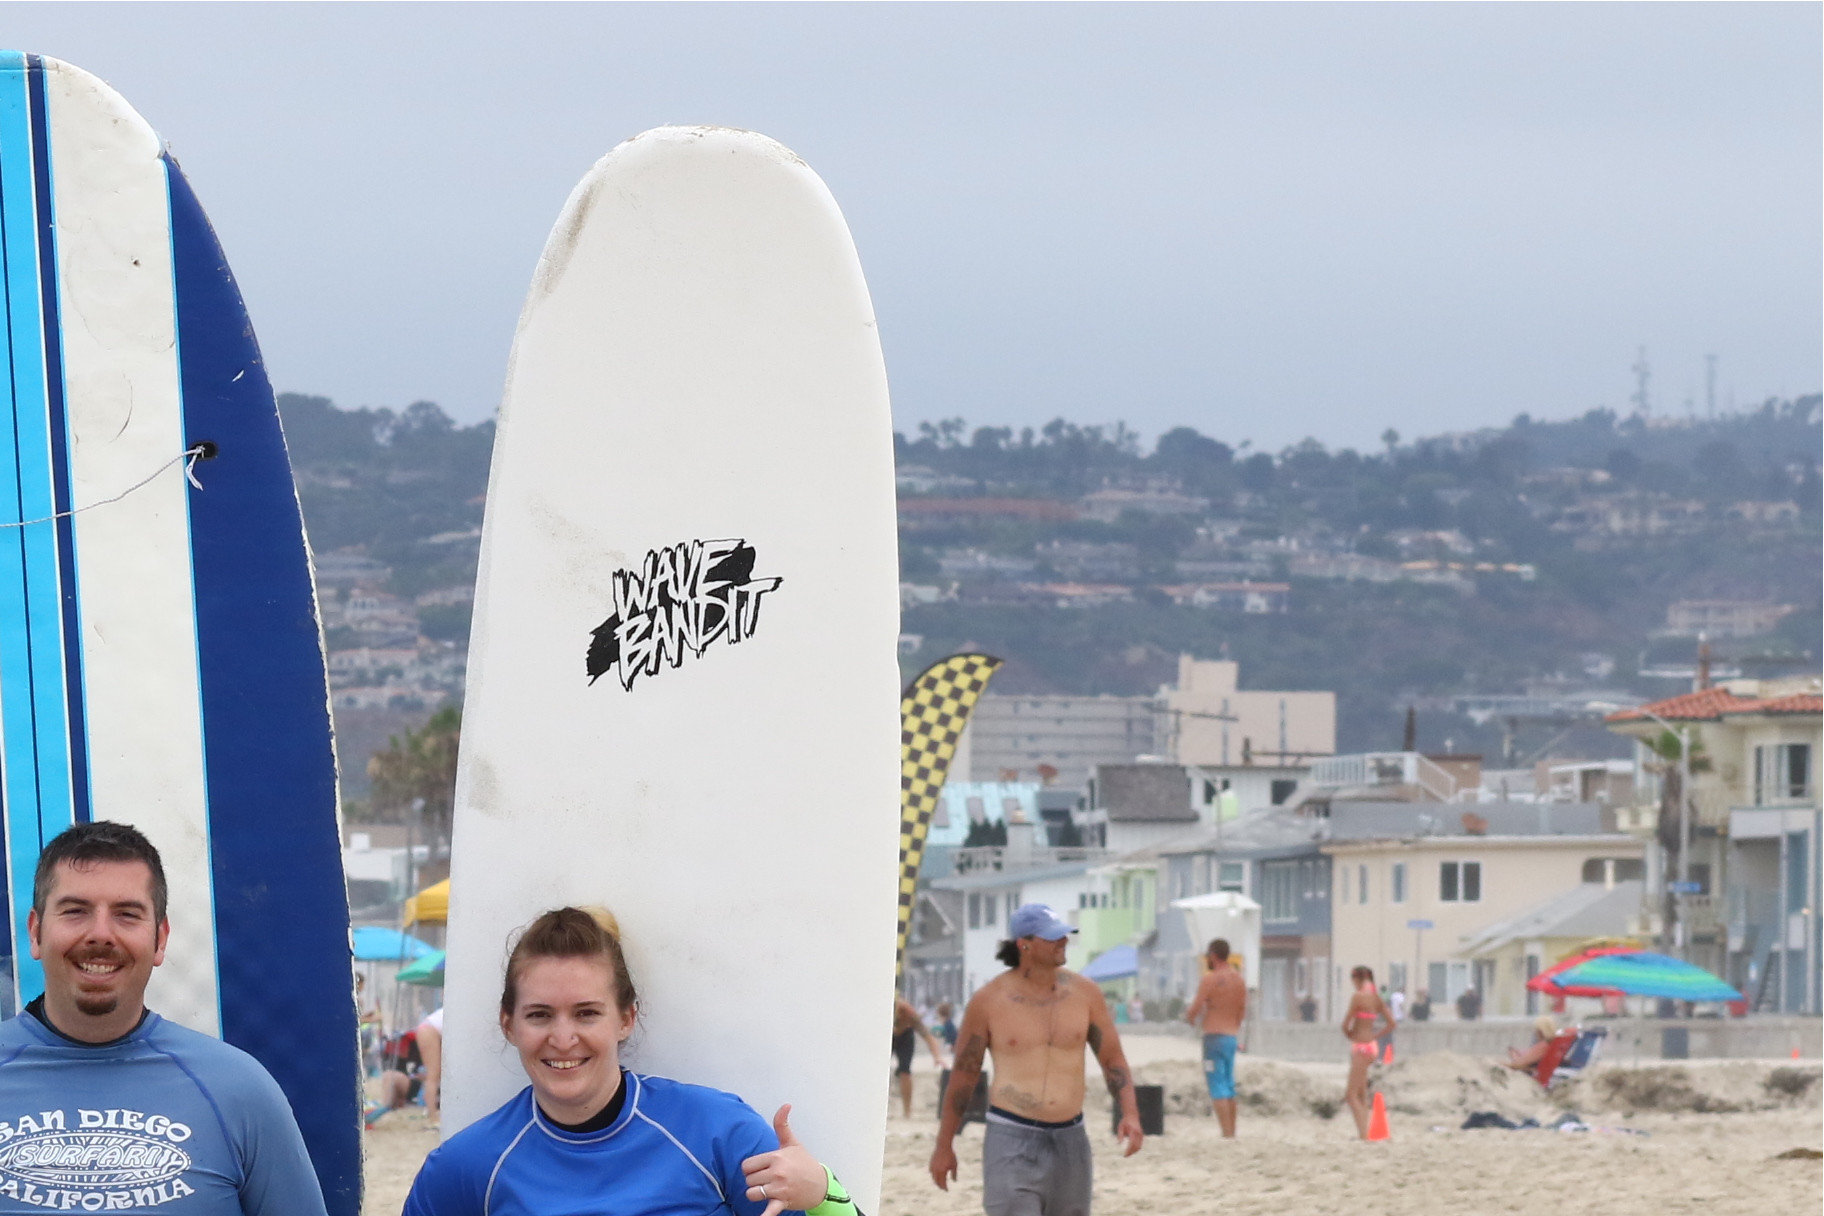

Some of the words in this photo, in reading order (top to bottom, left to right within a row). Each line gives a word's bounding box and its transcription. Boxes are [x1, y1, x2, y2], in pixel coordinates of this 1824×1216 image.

[612, 539, 745, 622] WAVE
[613, 577, 784, 692] BANDIT
[77, 1108, 192, 1143] DIEGO
[13, 1144, 163, 1168] SURFARI
